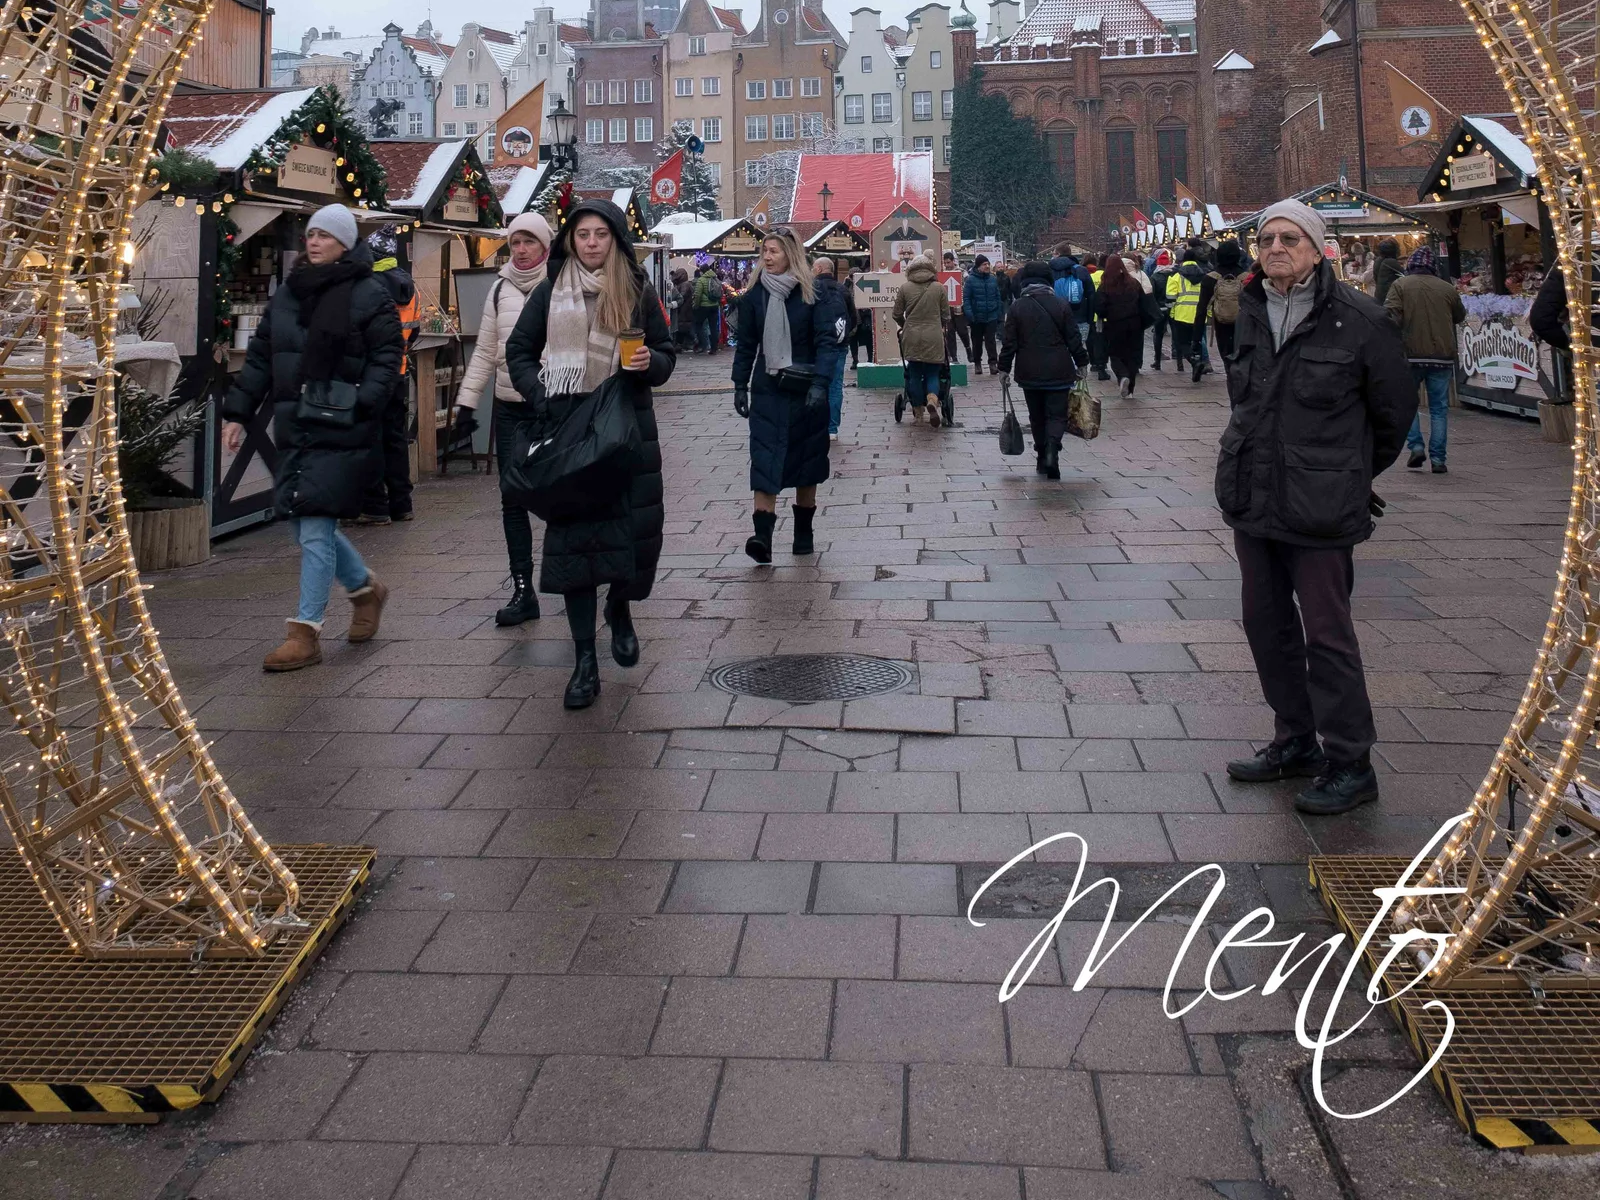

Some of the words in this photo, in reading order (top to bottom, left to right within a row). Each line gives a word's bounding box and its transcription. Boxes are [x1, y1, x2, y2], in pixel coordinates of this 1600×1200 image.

[886, 286, 900, 294] TRO
[1465, 328, 1535, 371] Squisitissimo
[1487, 374, 1501, 383] ITALIAN
[1501, 375, 1514, 384] FOOD
